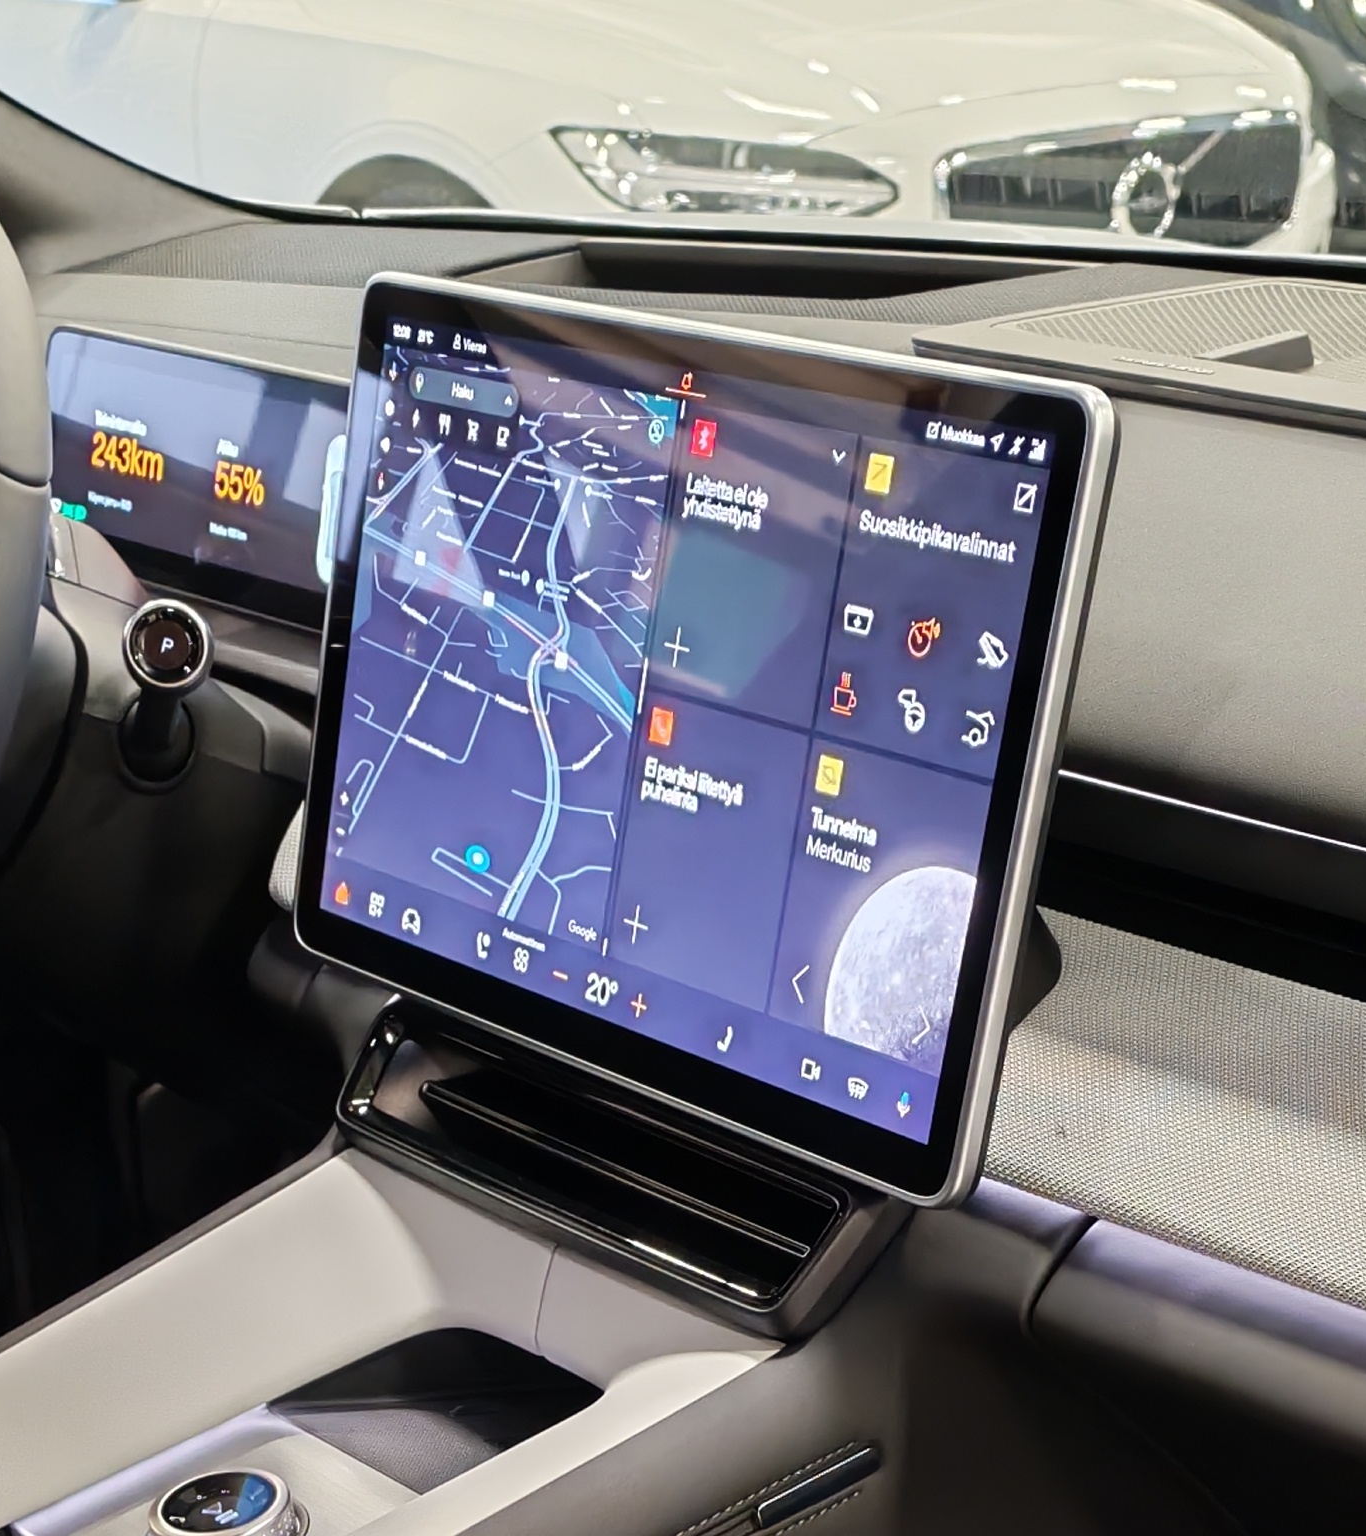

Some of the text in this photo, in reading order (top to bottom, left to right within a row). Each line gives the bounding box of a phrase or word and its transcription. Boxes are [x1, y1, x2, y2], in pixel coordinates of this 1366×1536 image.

[451, 381, 474, 401] Haku
[91, 430, 164, 482] 243km
[214, 460, 265, 506] 55%
[686, 471, 733, 502] Laitetta
[747, 486, 769, 510] ole
[859, 509, 1018, 563] Suosikkipikavalinnat
[160, 637, 175, 654] P
[811, 806, 878, 847] Tunnelma
[805, 834, 872, 874] Merkurius
[568, 919, 598, 942] Google
